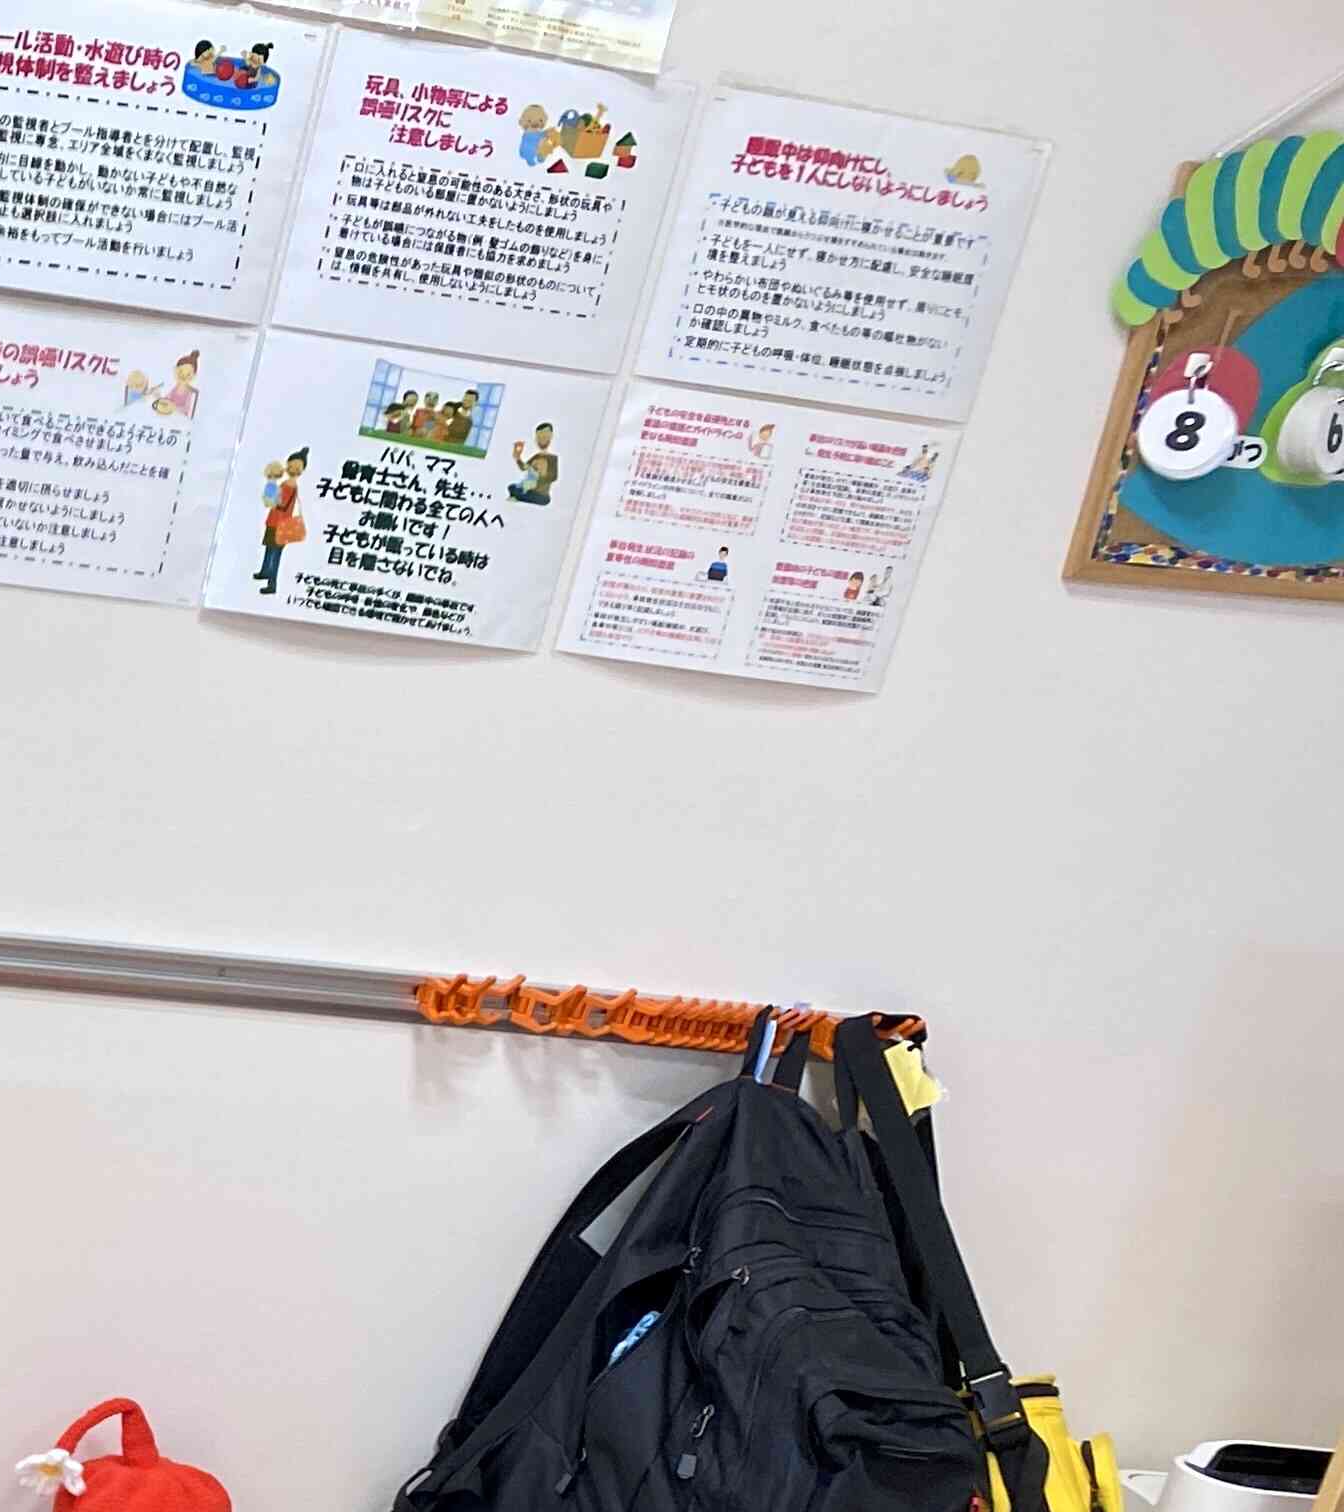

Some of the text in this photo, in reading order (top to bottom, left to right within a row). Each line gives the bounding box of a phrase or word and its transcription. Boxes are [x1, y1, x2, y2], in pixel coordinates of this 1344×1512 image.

[389, 124, 494, 157] 注意しましょう
[1166, 411, 1206, 451] 8
[1327, 412, 1343, 454] 6
